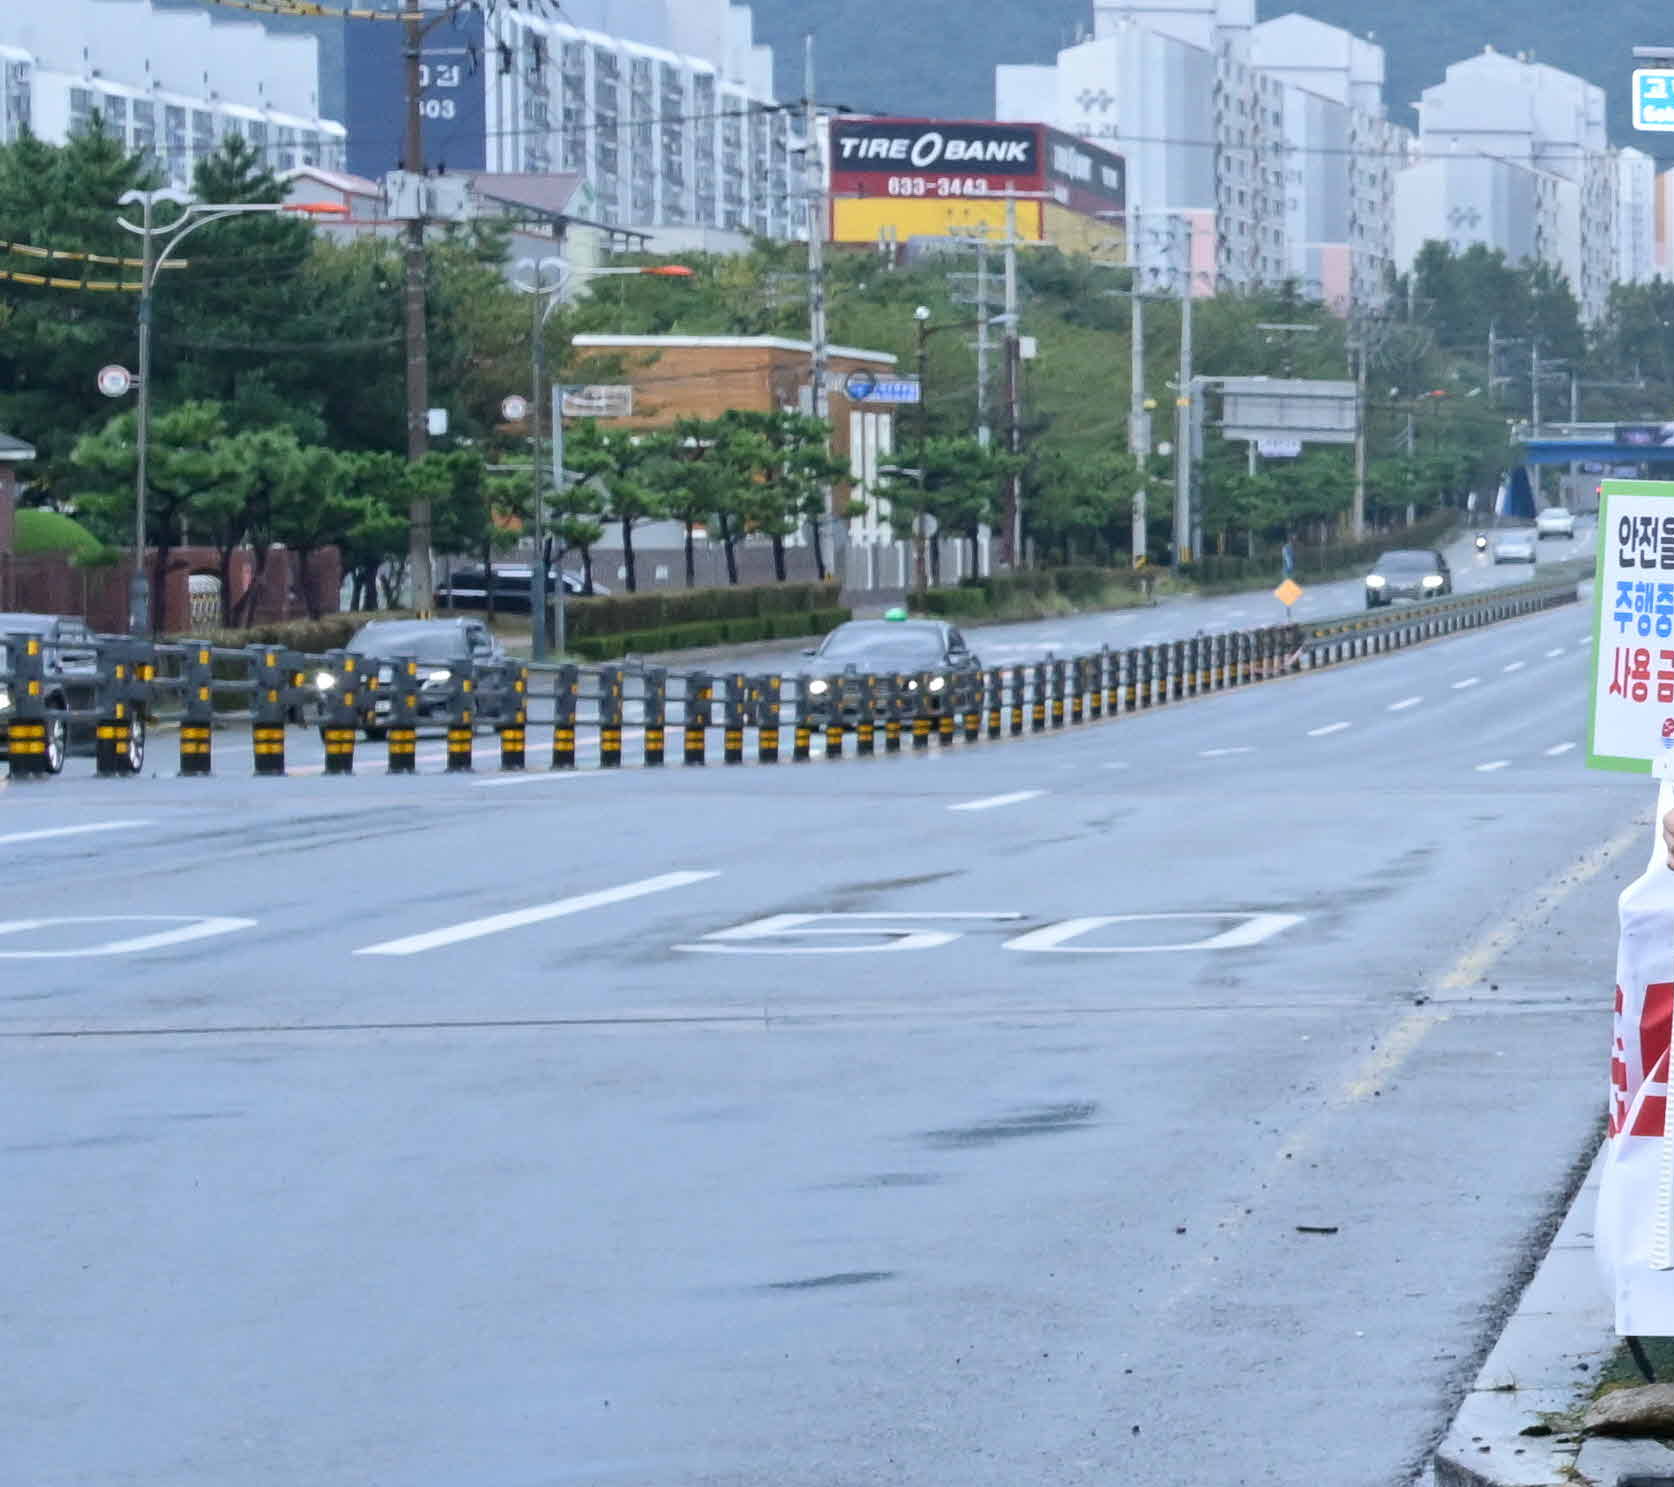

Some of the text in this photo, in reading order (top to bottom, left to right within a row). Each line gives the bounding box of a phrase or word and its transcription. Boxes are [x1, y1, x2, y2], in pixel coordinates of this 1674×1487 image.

[839, 138, 910, 160] TIRE
[944, 140, 1030, 162] BANK
[1608, 646, 1651, 703] 사용
[669, 912, 1309, 954] 50
